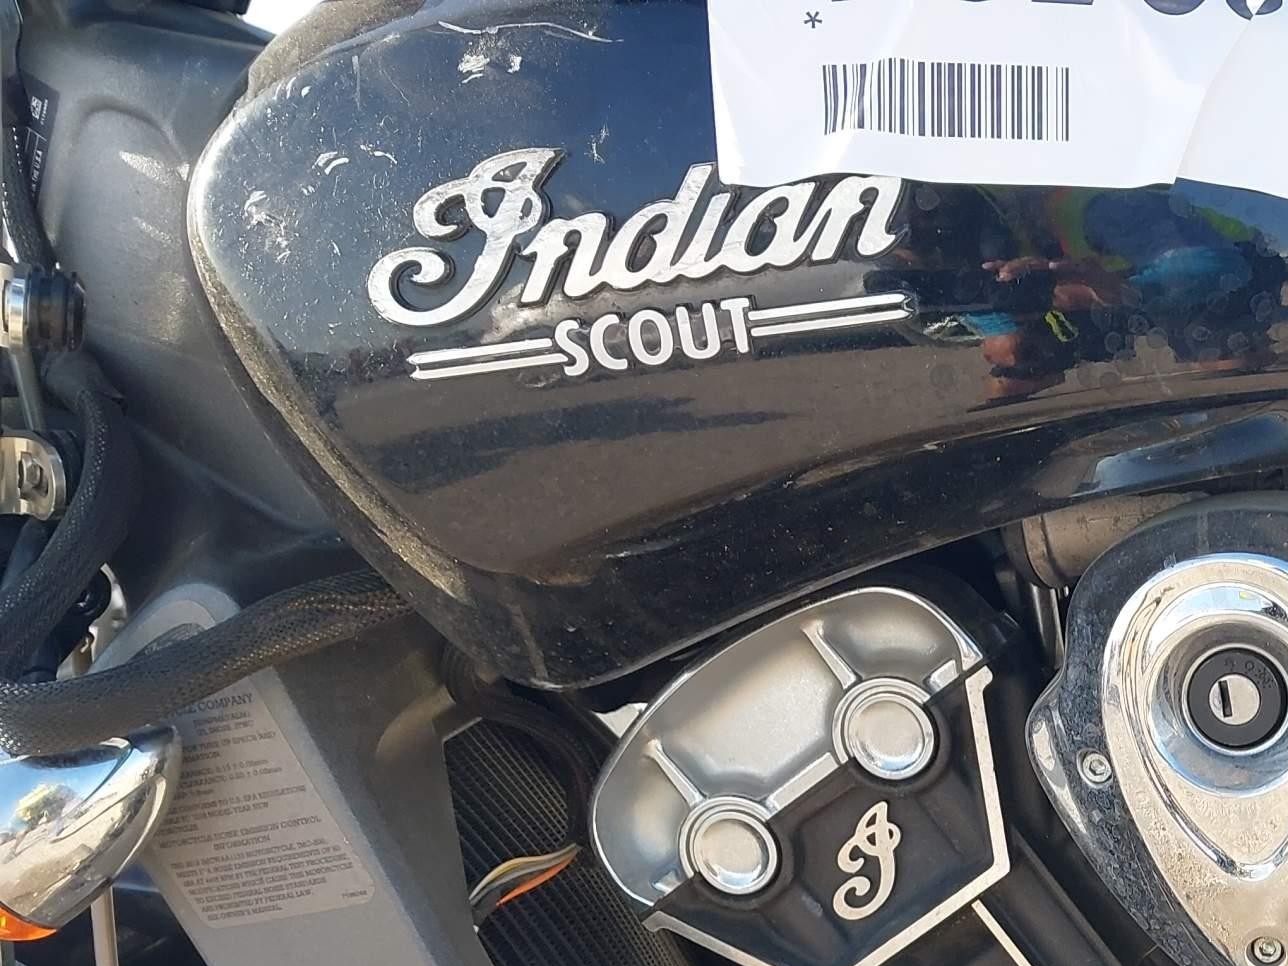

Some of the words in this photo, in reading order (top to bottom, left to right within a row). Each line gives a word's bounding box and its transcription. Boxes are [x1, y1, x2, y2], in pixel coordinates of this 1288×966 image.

[367, 148, 905, 326] Indian
[553, 296, 755, 377] SCOUT
[197, 692, 253, 712] COMPANY
